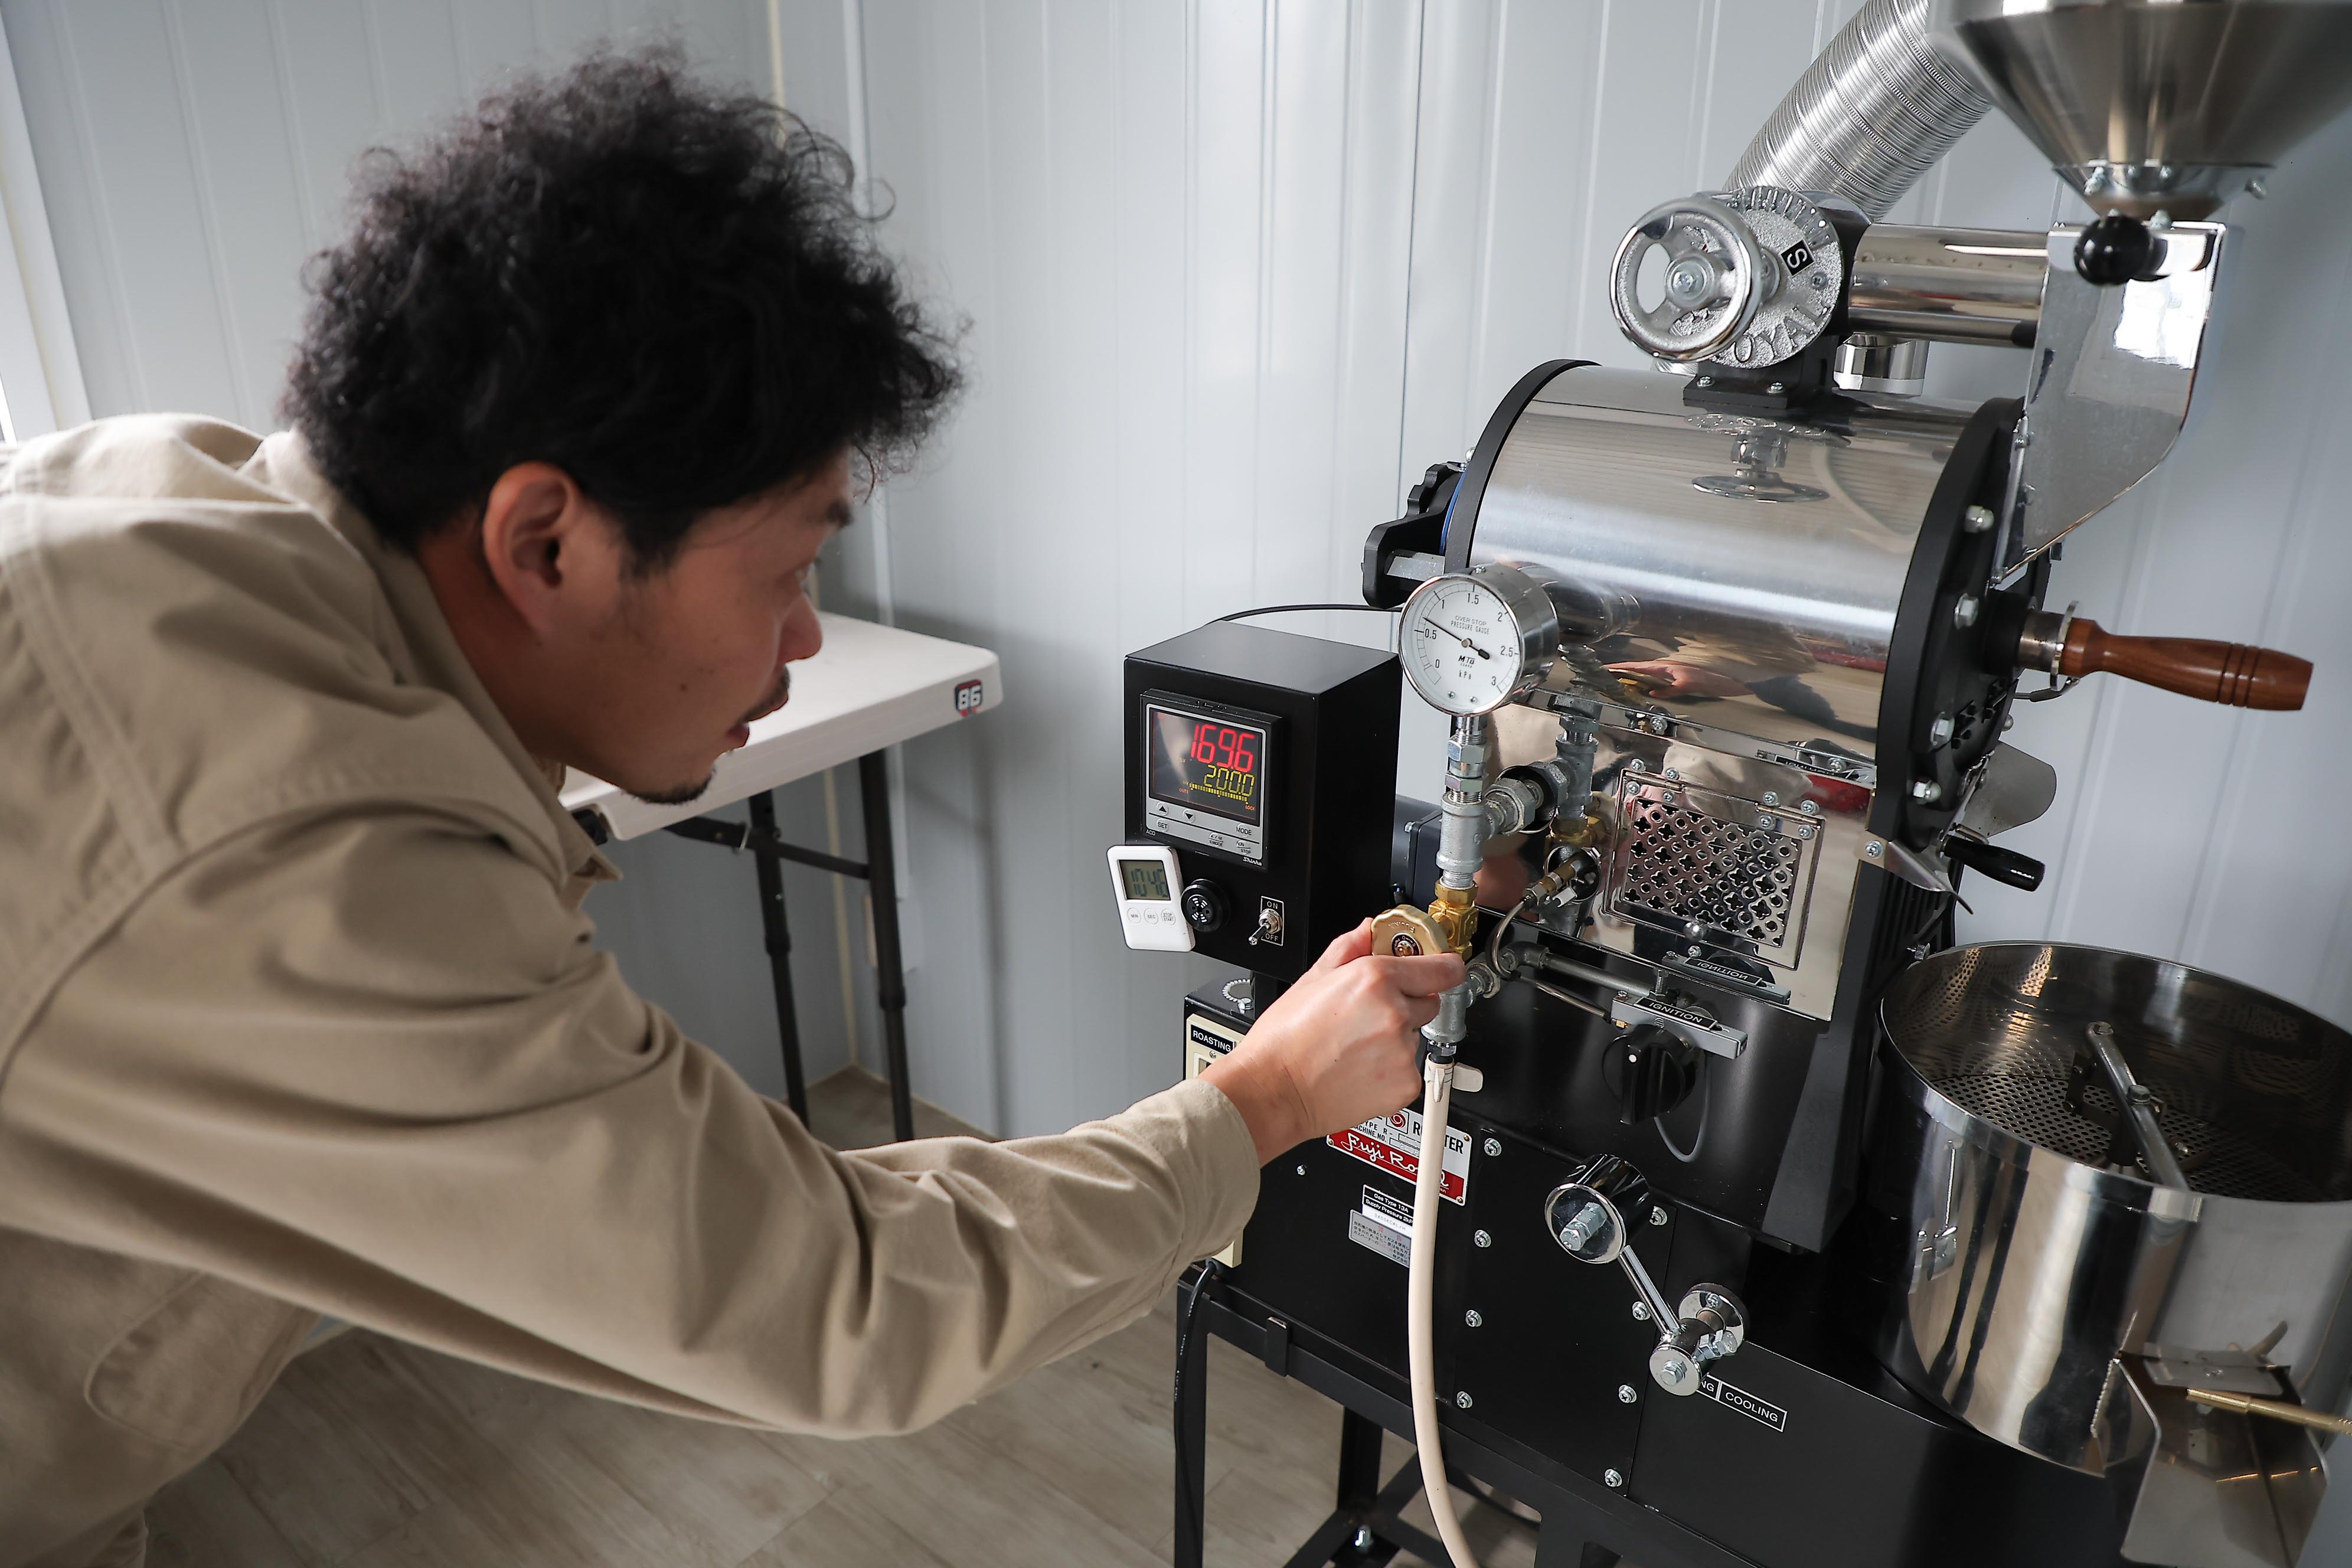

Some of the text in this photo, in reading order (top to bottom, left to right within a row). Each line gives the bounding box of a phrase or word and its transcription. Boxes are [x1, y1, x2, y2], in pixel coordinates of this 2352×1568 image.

[1787, 248, 1808, 269] S
[1733, 304, 1830, 362] OYAL
[1442, 599, 1445, 609] 1
[1466, 593, 1479, 605] 1.5
[1497, 612, 1503, 622] 2
[1425, 628, 1437, 639] 0.5
[1451, 620, 1489, 635] PRESSURE GAUGE
[1501, 645, 1514, 657] 2.5
[1435, 659, 1440, 668] 0
[1491, 676, 1496, 686] 3
[958, 685, 981, 710] 86
[1158, 821, 1168, 829] SET
[1236, 827, 1252, 836] MODE
[1266, 901, 1278, 910] ON
[1265, 933, 1279, 942] OFF
[1649, 1002, 1703, 1023] IGNITION
[1193, 1030, 1231, 1052] ROASTING
[1365, 1121, 1378, 1131] YPE
[1340, 1132, 1385, 1162] Fuji
[1366, 1198, 1381, 1210] Supply
[1381, 1206, 1403, 1220] Pressure
[1374, 1193, 1409, 1213] Gas Type 13A
[1725, 1392, 1778, 1423] COOLING
